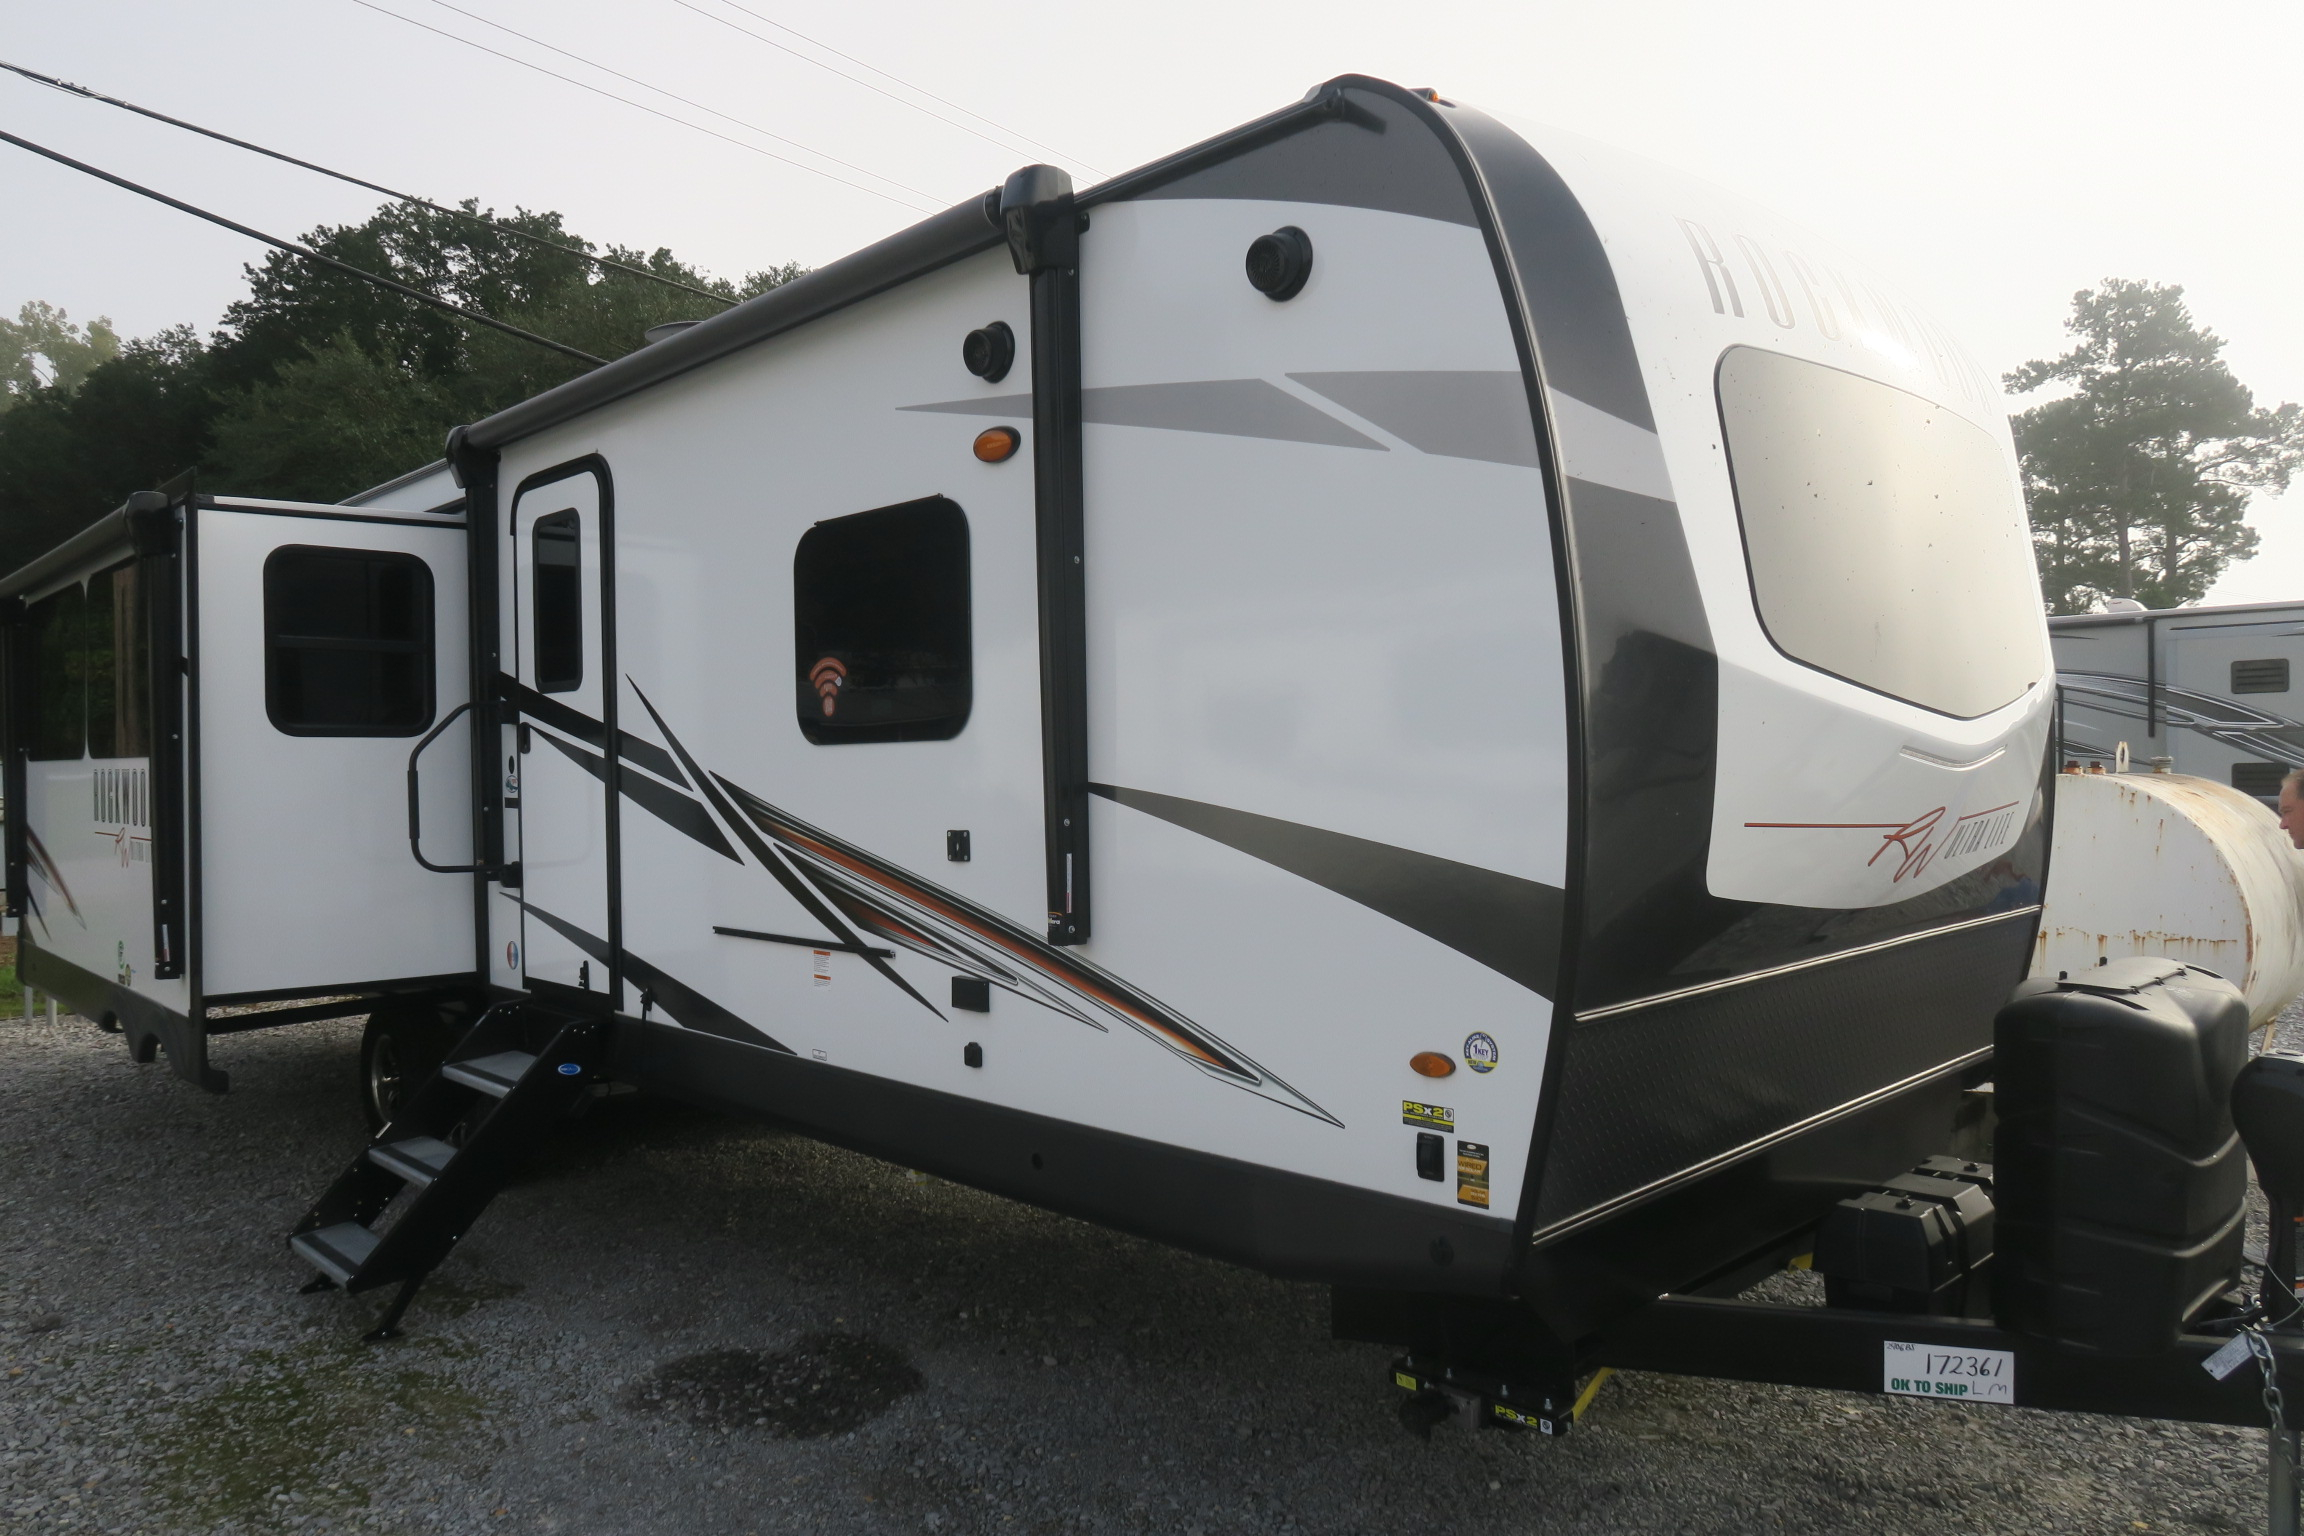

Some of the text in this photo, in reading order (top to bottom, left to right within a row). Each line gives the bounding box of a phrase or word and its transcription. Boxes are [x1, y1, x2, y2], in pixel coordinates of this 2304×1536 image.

[93, 768, 148, 827] ROCKWOO
[1926, 1353, 2003, 1377] 172361
[1891, 1377, 1968, 1396] OK TO SHIP
